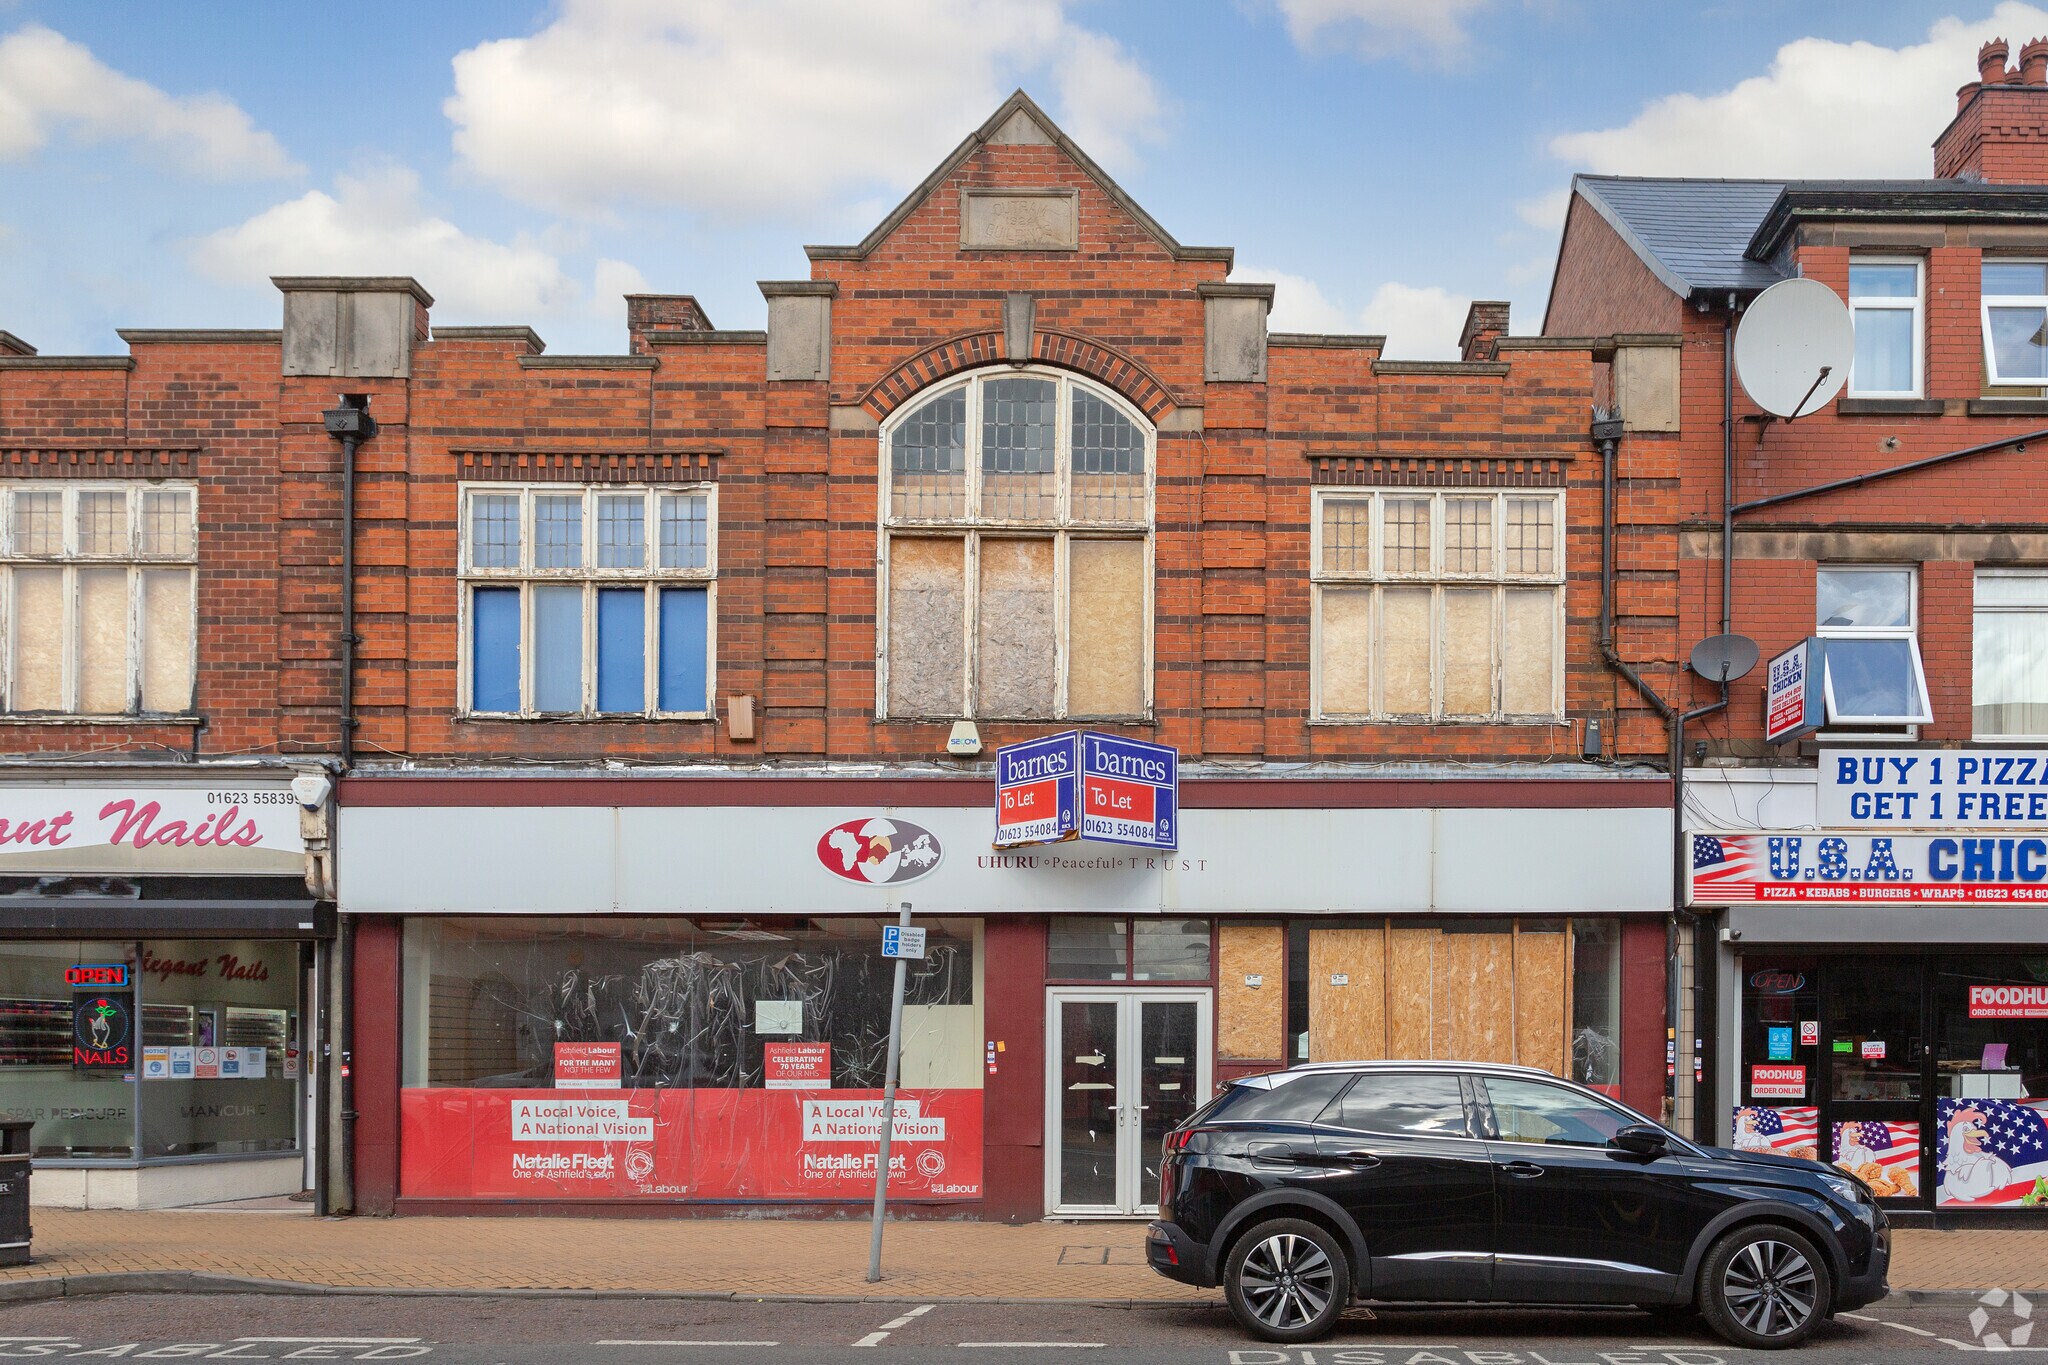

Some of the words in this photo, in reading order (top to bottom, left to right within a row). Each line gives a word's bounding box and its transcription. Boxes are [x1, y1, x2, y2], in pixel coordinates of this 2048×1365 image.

[1772, 670, 1802, 695] CHICKEN
[1007, 751, 1067, 781] barnes
[1094, 741, 1166, 781] barnes
[1836, 757, 1919, 785] BUY
[1929, 757, 1943, 785] 1
[207, 792, 249, 804] 01623
[1003, 791, 1015, 808] To
[1017, 789, 1035, 807] Let
[1091, 787, 1107, 805] To
[1111, 791, 1132, 809] Let
[1850, 792, 1919, 819] GET
[1929, 792, 1943, 819] 1
[1956, 792, 2048, 820] FREE
[98, 798, 264, 849] Nails
[999, 827, 1022, 840] 01623
[1024, 821, 1057, 836] 554084
[1085, 819, 1113, 834] 01623
[1117, 823, 1154, 839] 554084
[977, 855, 1040, 869] UHURU
[1052, 856, 1116, 869] Peaceful
[1129, 857, 1208, 871] TRUST
[1768, 837, 1913, 880] U.S.A.
[1928, 838, 2047, 881] CHIC
[1764, 887, 1797, 898] PIZZA
[1806, 887, 1850, 898] KEBABS
[1860, 887, 1911, 898] BURGERS
[1921, 888, 1965, 898] WRAPS
[1975, 888, 2008, 899] 01623
[888, 929, 898, 940] P
[65, 967, 124, 984] OPEN
[217, 953, 270, 982] Nails
[1755, 973, 1801, 989] OPEN
[1971, 987, 2048, 1005] FOODHU
[1971, 1008, 1996, 1016] ORDER
[1997, 1008, 2023, 1016] ONLINE
[74, 1047, 129, 1065] NAILS
[1754, 1070, 1803, 1080] FOODHUB
[51, 1108, 127, 1120] PEDICURE
[181, 1104, 266, 1118] MANICURE
[520, 1106, 531, 1117] A
[535, 1105, 573, 1117] Local
[577, 1105, 620, 1119] Voice,
[811, 1106, 822, 1117] A
[826, 1106, 864, 1118] Local
[869, 1106, 911, 1119] Voce,
[520, 1123, 531, 1134] A
[535, 1122, 599, 1135] National
[603, 1122, 647, 1135] Vision
[811, 1123, 822, 1134] A
[826, 1123, 884, 1135] Nationa
[894, 1123, 938, 1135] Vision
[512, 1153, 570, 1169] Natalie
[572, 1153, 614, 1169] Fleet
[804, 1153, 861, 1169] Natalie
[863, 1153, 906, 1169] Flet
[512, 1170, 531, 1179] One
[534, 1169, 545, 1179] of
[547, 1169, 592, 1179] Ashfield's
[804, 1170, 823, 1179] One
[826, 1169, 836, 1179] of
[838, 1169, 879, 1179] Ashfield'
[650, 1183, 688, 1194] Labour
[941, 1183, 978, 1193] Labour
[0, 1342, 433, 1360] SABLED
[1228, 1351, 1726, 1365] DISABLED
